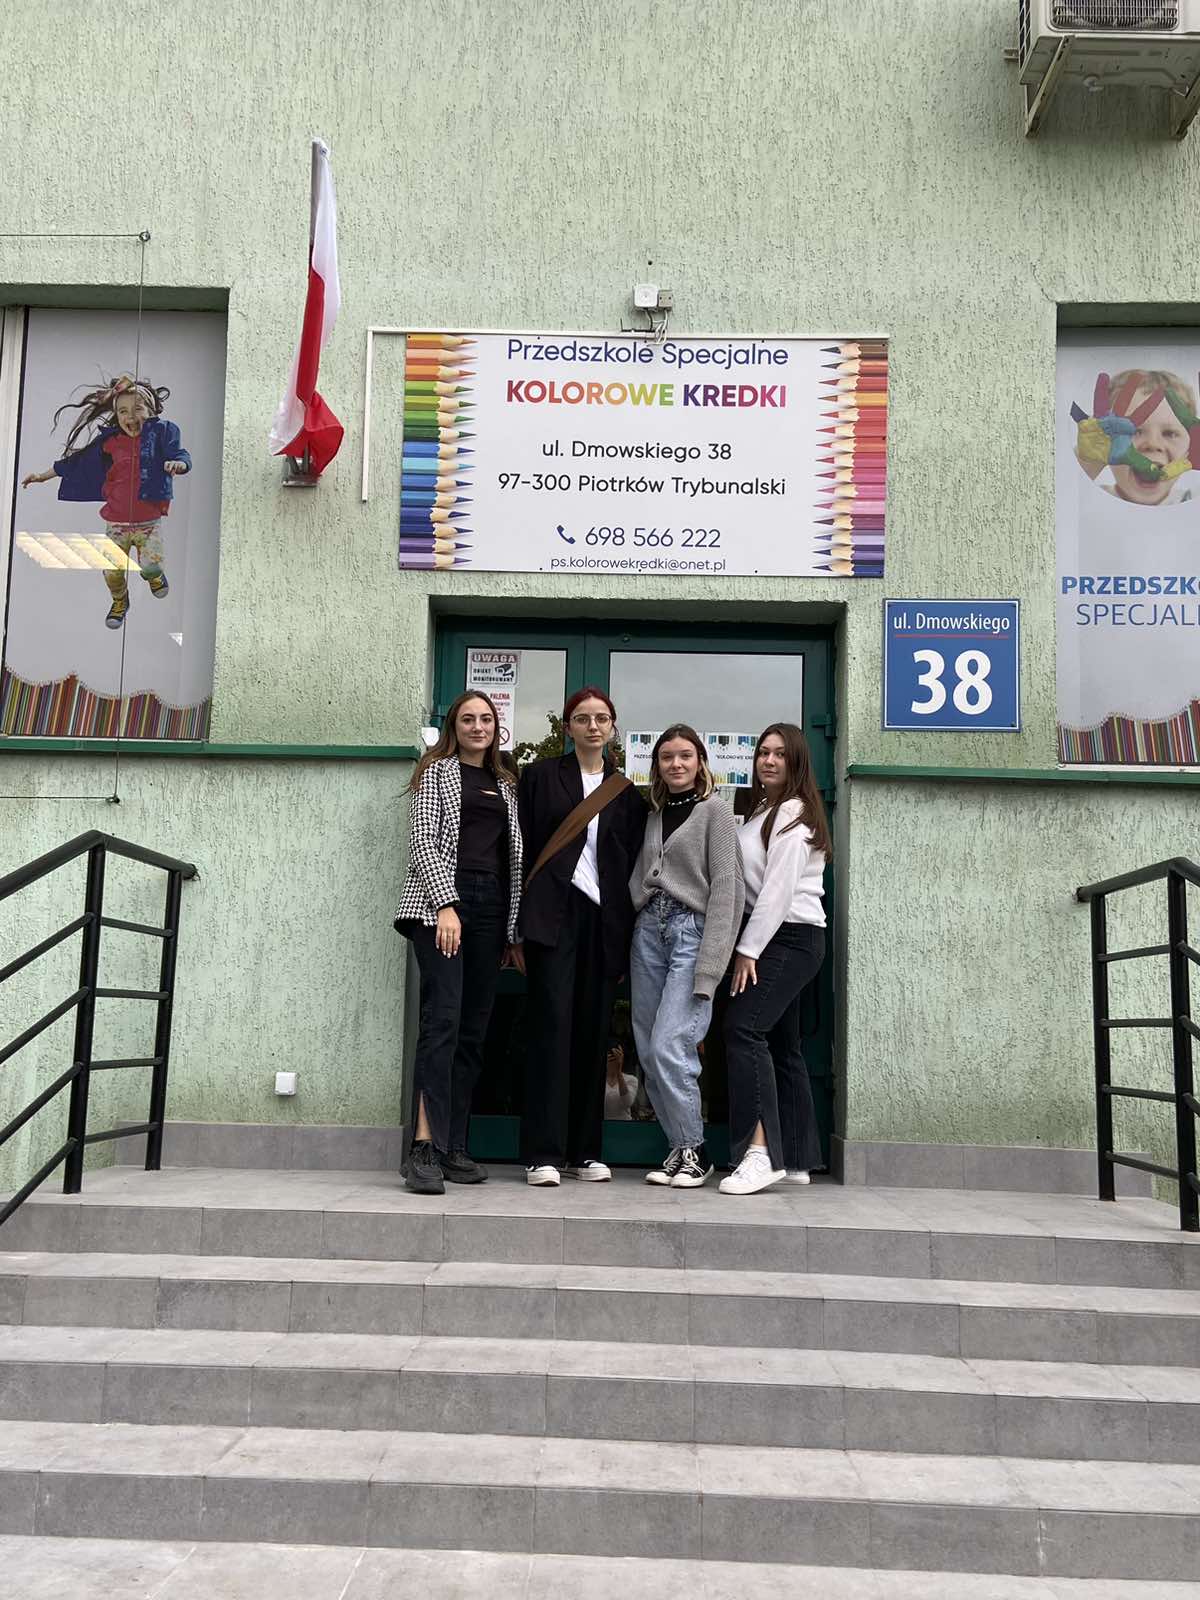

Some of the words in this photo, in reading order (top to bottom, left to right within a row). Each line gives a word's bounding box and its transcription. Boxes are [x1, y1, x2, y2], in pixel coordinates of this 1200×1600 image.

[508, 339, 654, 364] Przedszkole
[662, 342, 789, 370] Specjalne
[507, 379, 674, 406] KOLOROWE
[683, 383, 787, 408] KREDKI
[542, 439, 564, 457] ul.
[571, 440, 701, 463] Dmowskiego
[708, 442, 732, 460] 38
[498, 472, 571, 491] 97-300
[578, 474, 665, 493] Piotrków
[671, 476, 786, 497] Trybunalski
[585, 526, 626, 546] 698
[632, 527, 674, 547] 566
[680, 528, 721, 548] 222
[550, 556, 726, 573] ps.kolorowekredki@onet.pl
[1062, 576, 1200, 595] PRZEDSZK
[893, 611, 912, 631] ul.
[915, 612, 1011, 634] Dmowskiego
[474, 654, 516, 663] UWAGA
[910, 649, 993, 715] 38
